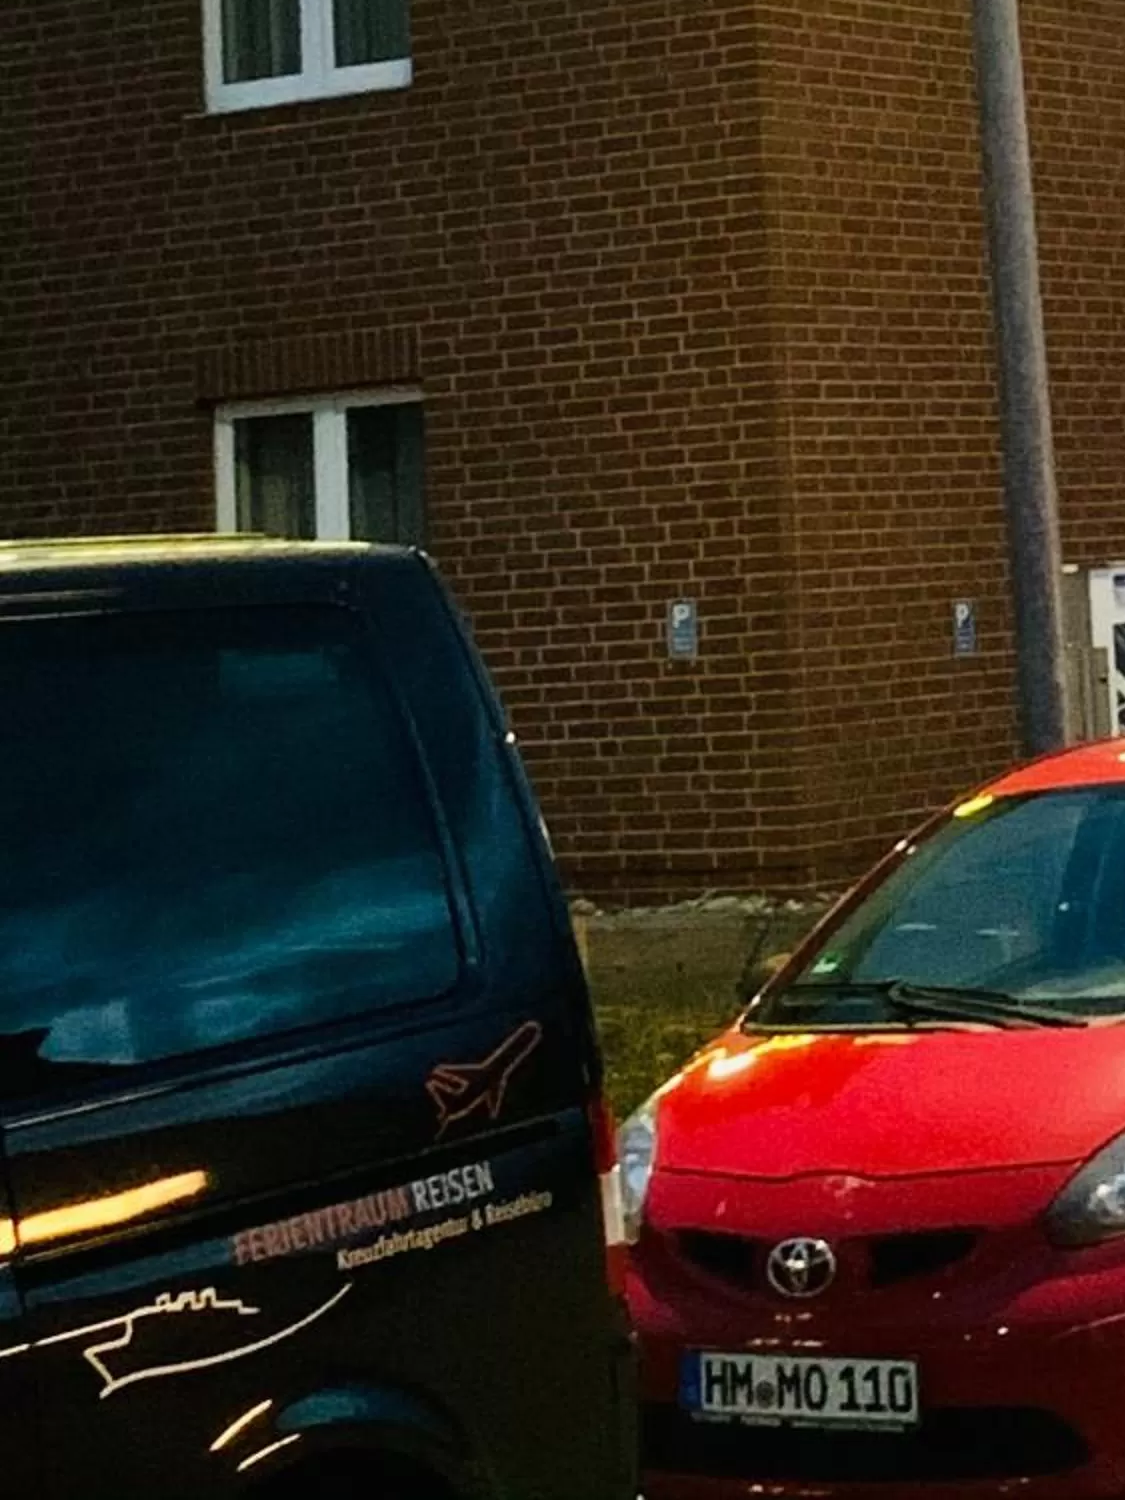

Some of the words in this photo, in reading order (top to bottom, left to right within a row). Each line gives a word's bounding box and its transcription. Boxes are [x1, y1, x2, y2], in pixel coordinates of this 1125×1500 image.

[672, 603, 690, 629] P
[955, 603, 969, 629] P
[233, 1186, 410, 1266] FERIENTRAUM
[411, 1160, 495, 1213] REISEN
[704, 1359, 754, 1405] HM
[775, 1362, 828, 1411] MO
[838, 1365, 913, 1413] 110
